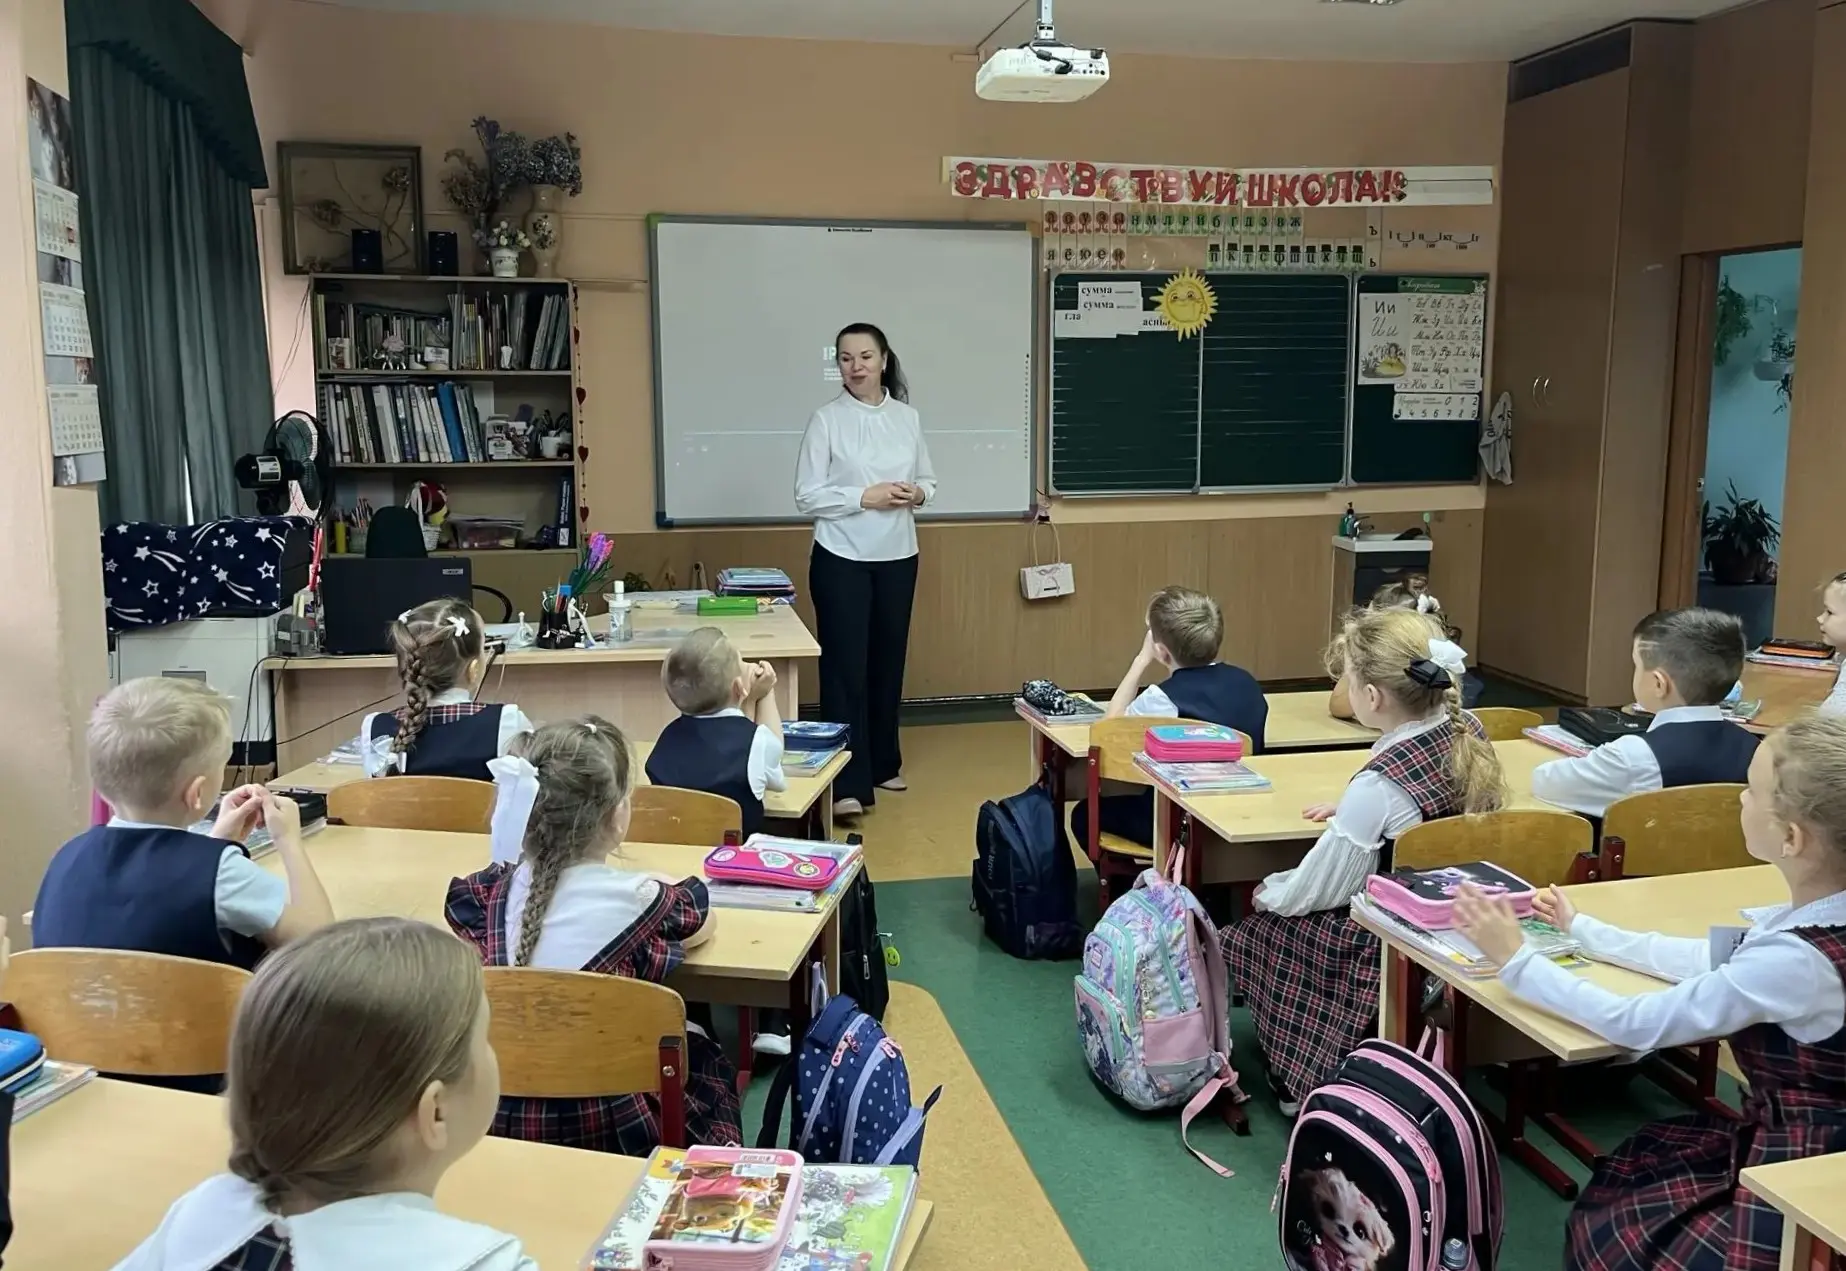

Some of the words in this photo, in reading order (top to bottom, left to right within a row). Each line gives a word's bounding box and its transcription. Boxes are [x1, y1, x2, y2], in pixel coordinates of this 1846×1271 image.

[954, 161, 1239, 205] ЗДРАВСТВУЙ
[1081, 287, 1112, 296] сумма
[1083, 302, 1115, 311] сумма
